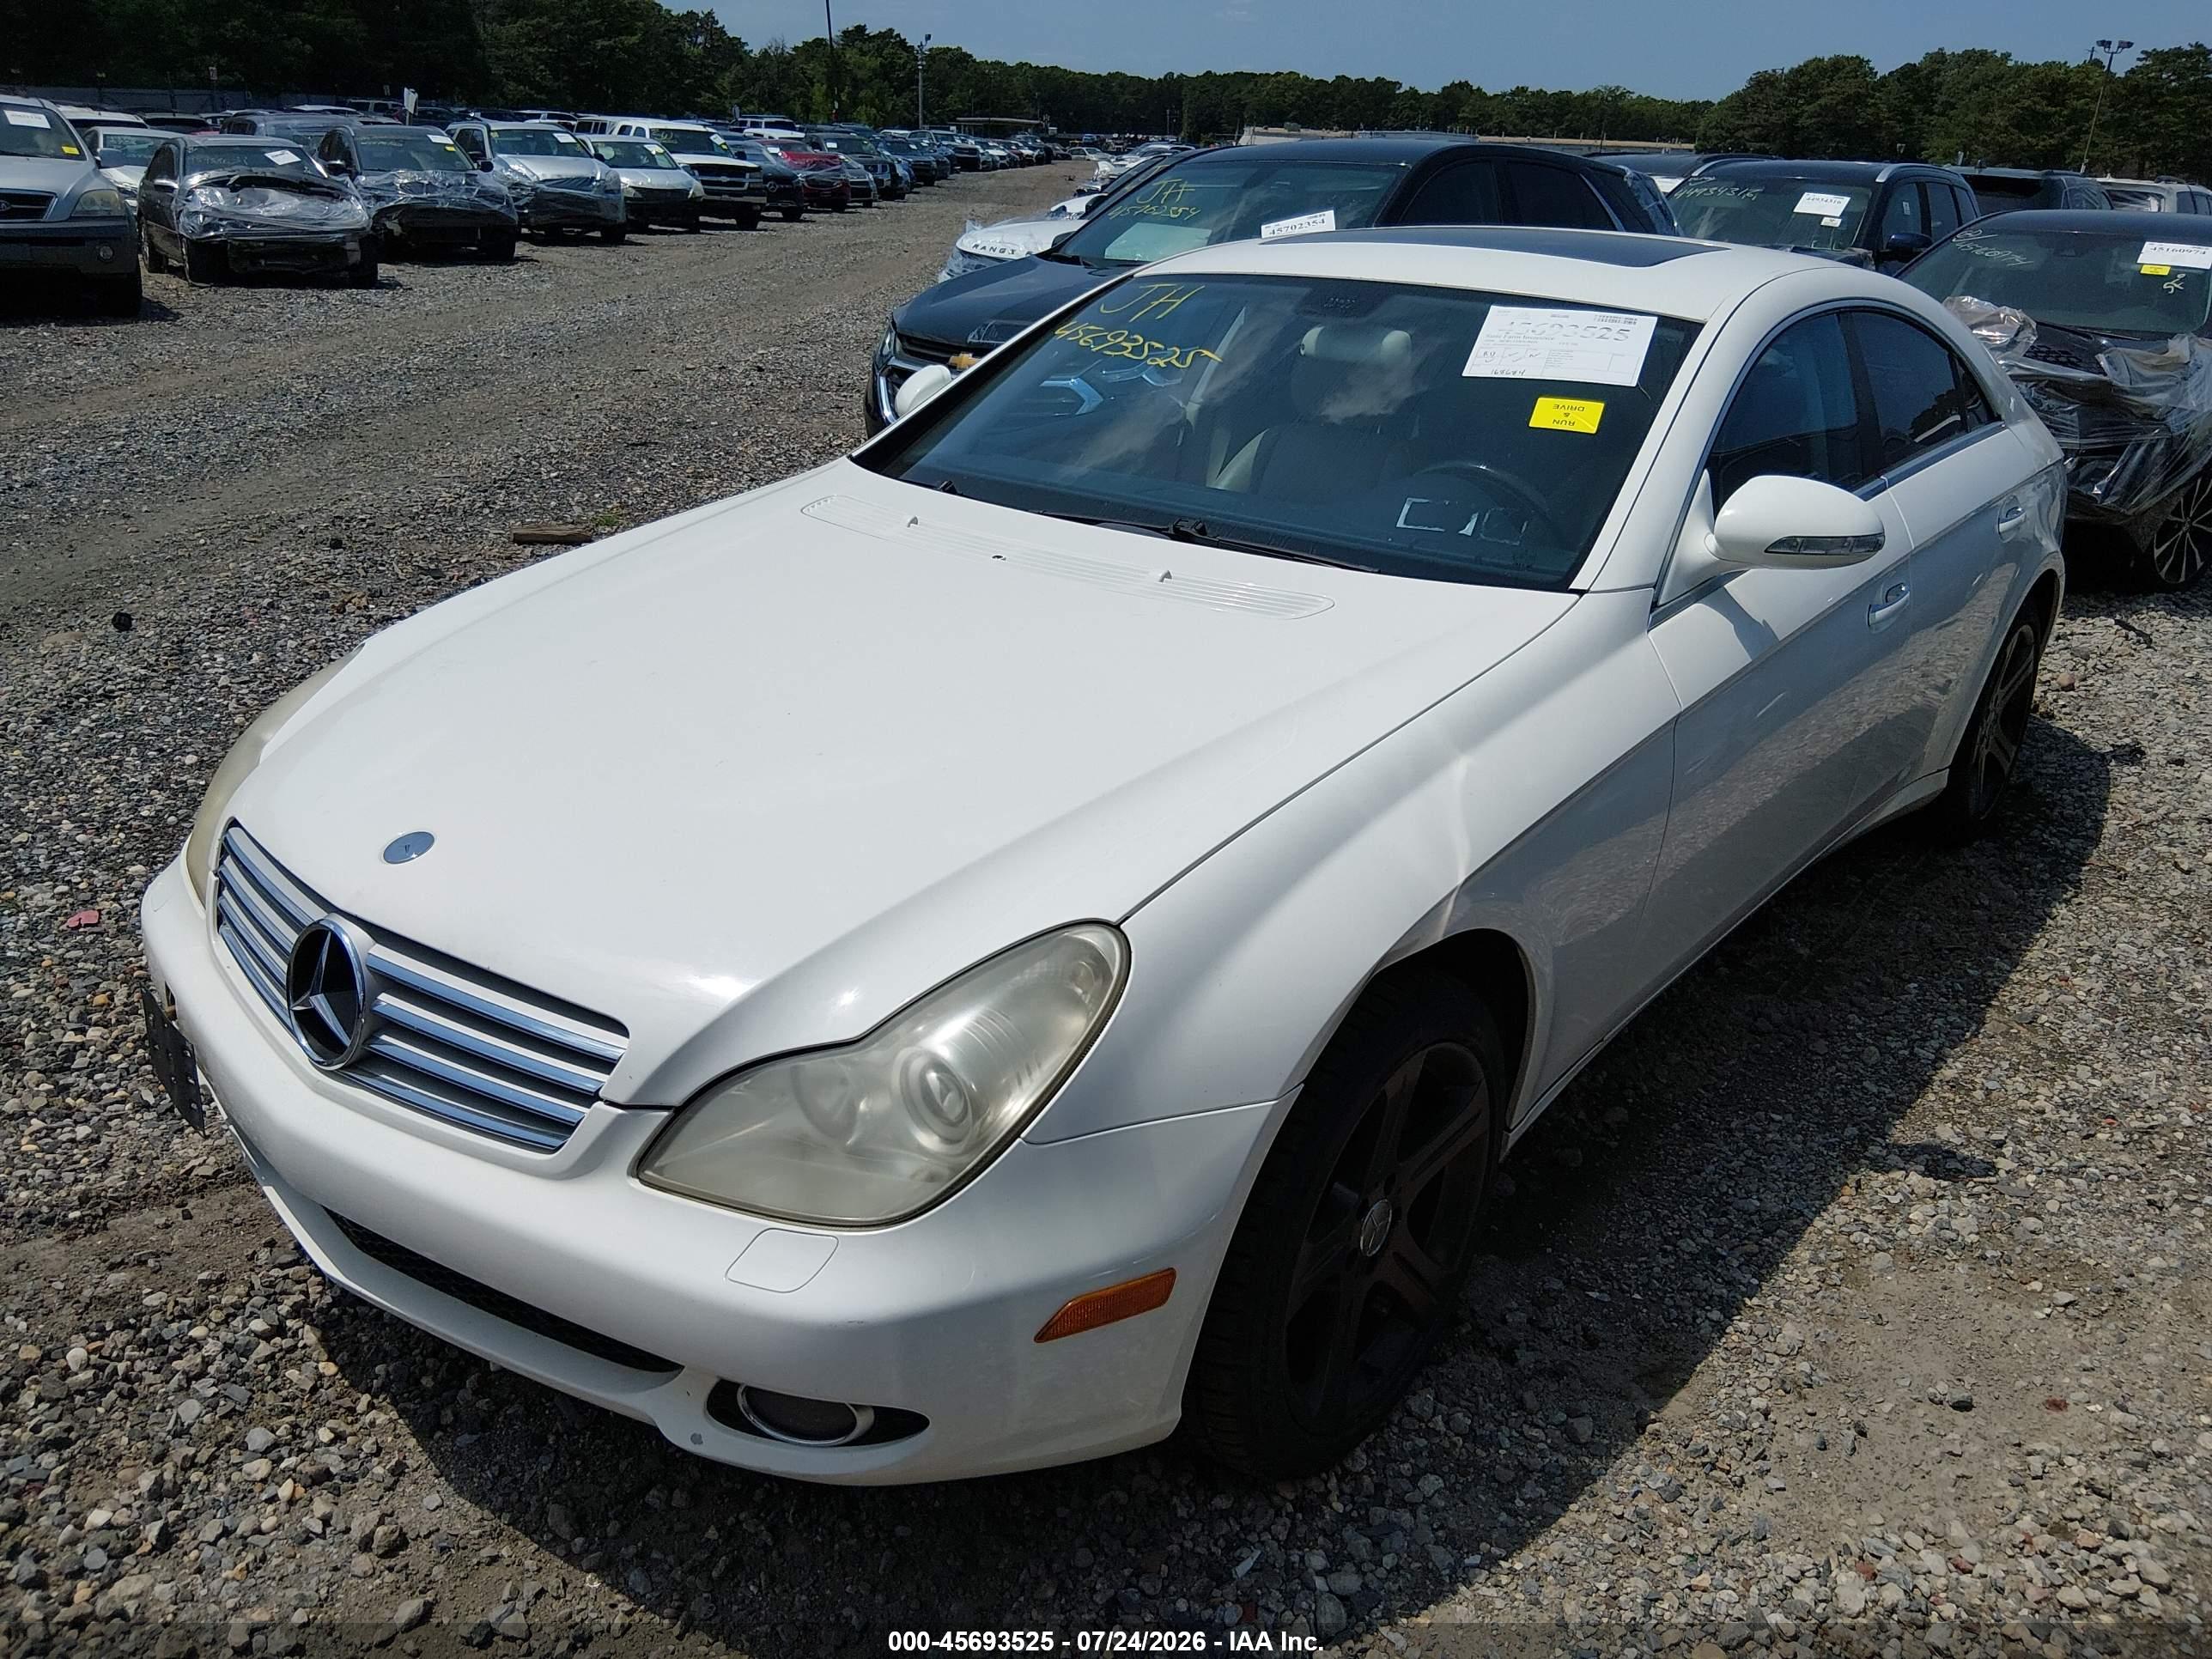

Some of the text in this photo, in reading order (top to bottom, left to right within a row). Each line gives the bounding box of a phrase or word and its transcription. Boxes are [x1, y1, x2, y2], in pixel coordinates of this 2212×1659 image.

[1269, 218, 1326, 235] 45702354
[1054, 320, 1223, 368] 45693525
[1553, 404, 1585, 412] DRIVE
